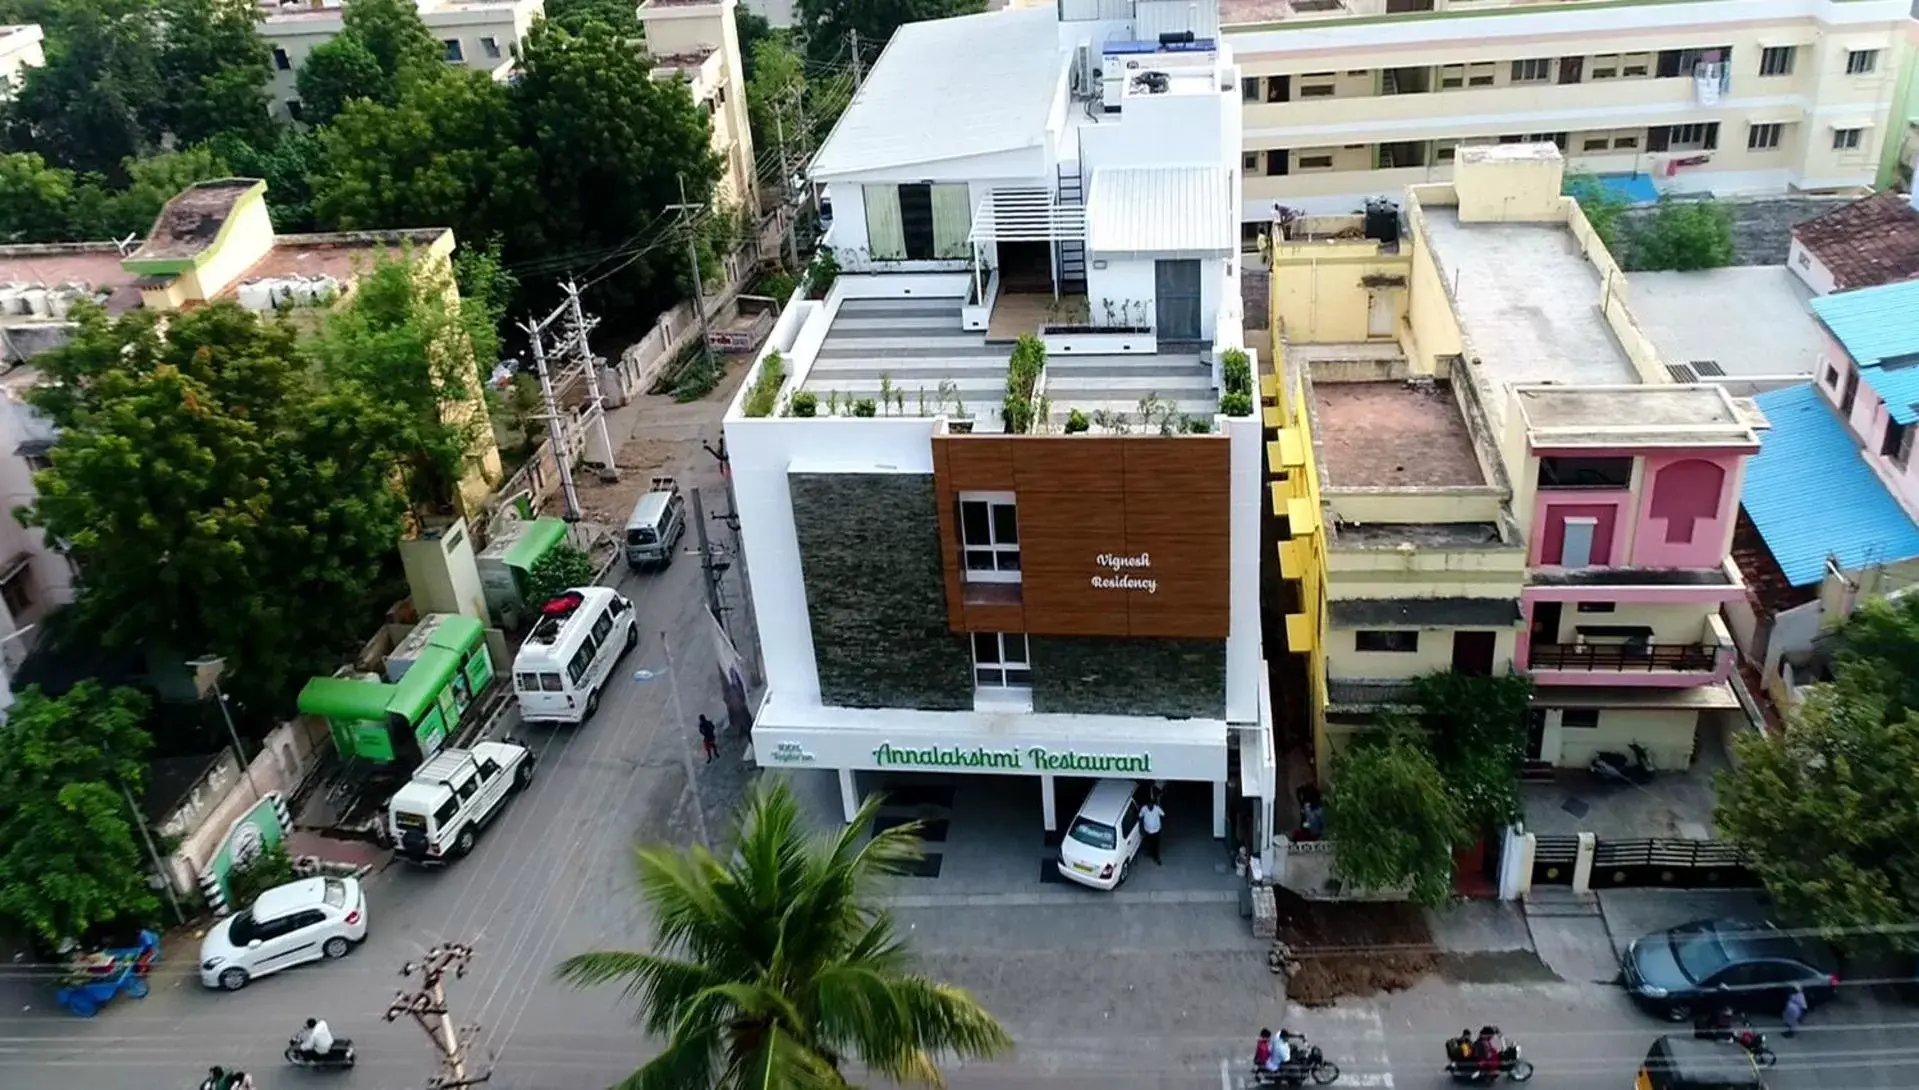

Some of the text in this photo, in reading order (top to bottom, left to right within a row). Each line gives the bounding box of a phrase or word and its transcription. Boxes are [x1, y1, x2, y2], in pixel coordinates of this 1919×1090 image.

[1096, 552, 1151, 572] Vignesh
[1091, 574, 1157, 595] Residency
[872, 743, 1151, 773] Annalakshmi Restaurant
